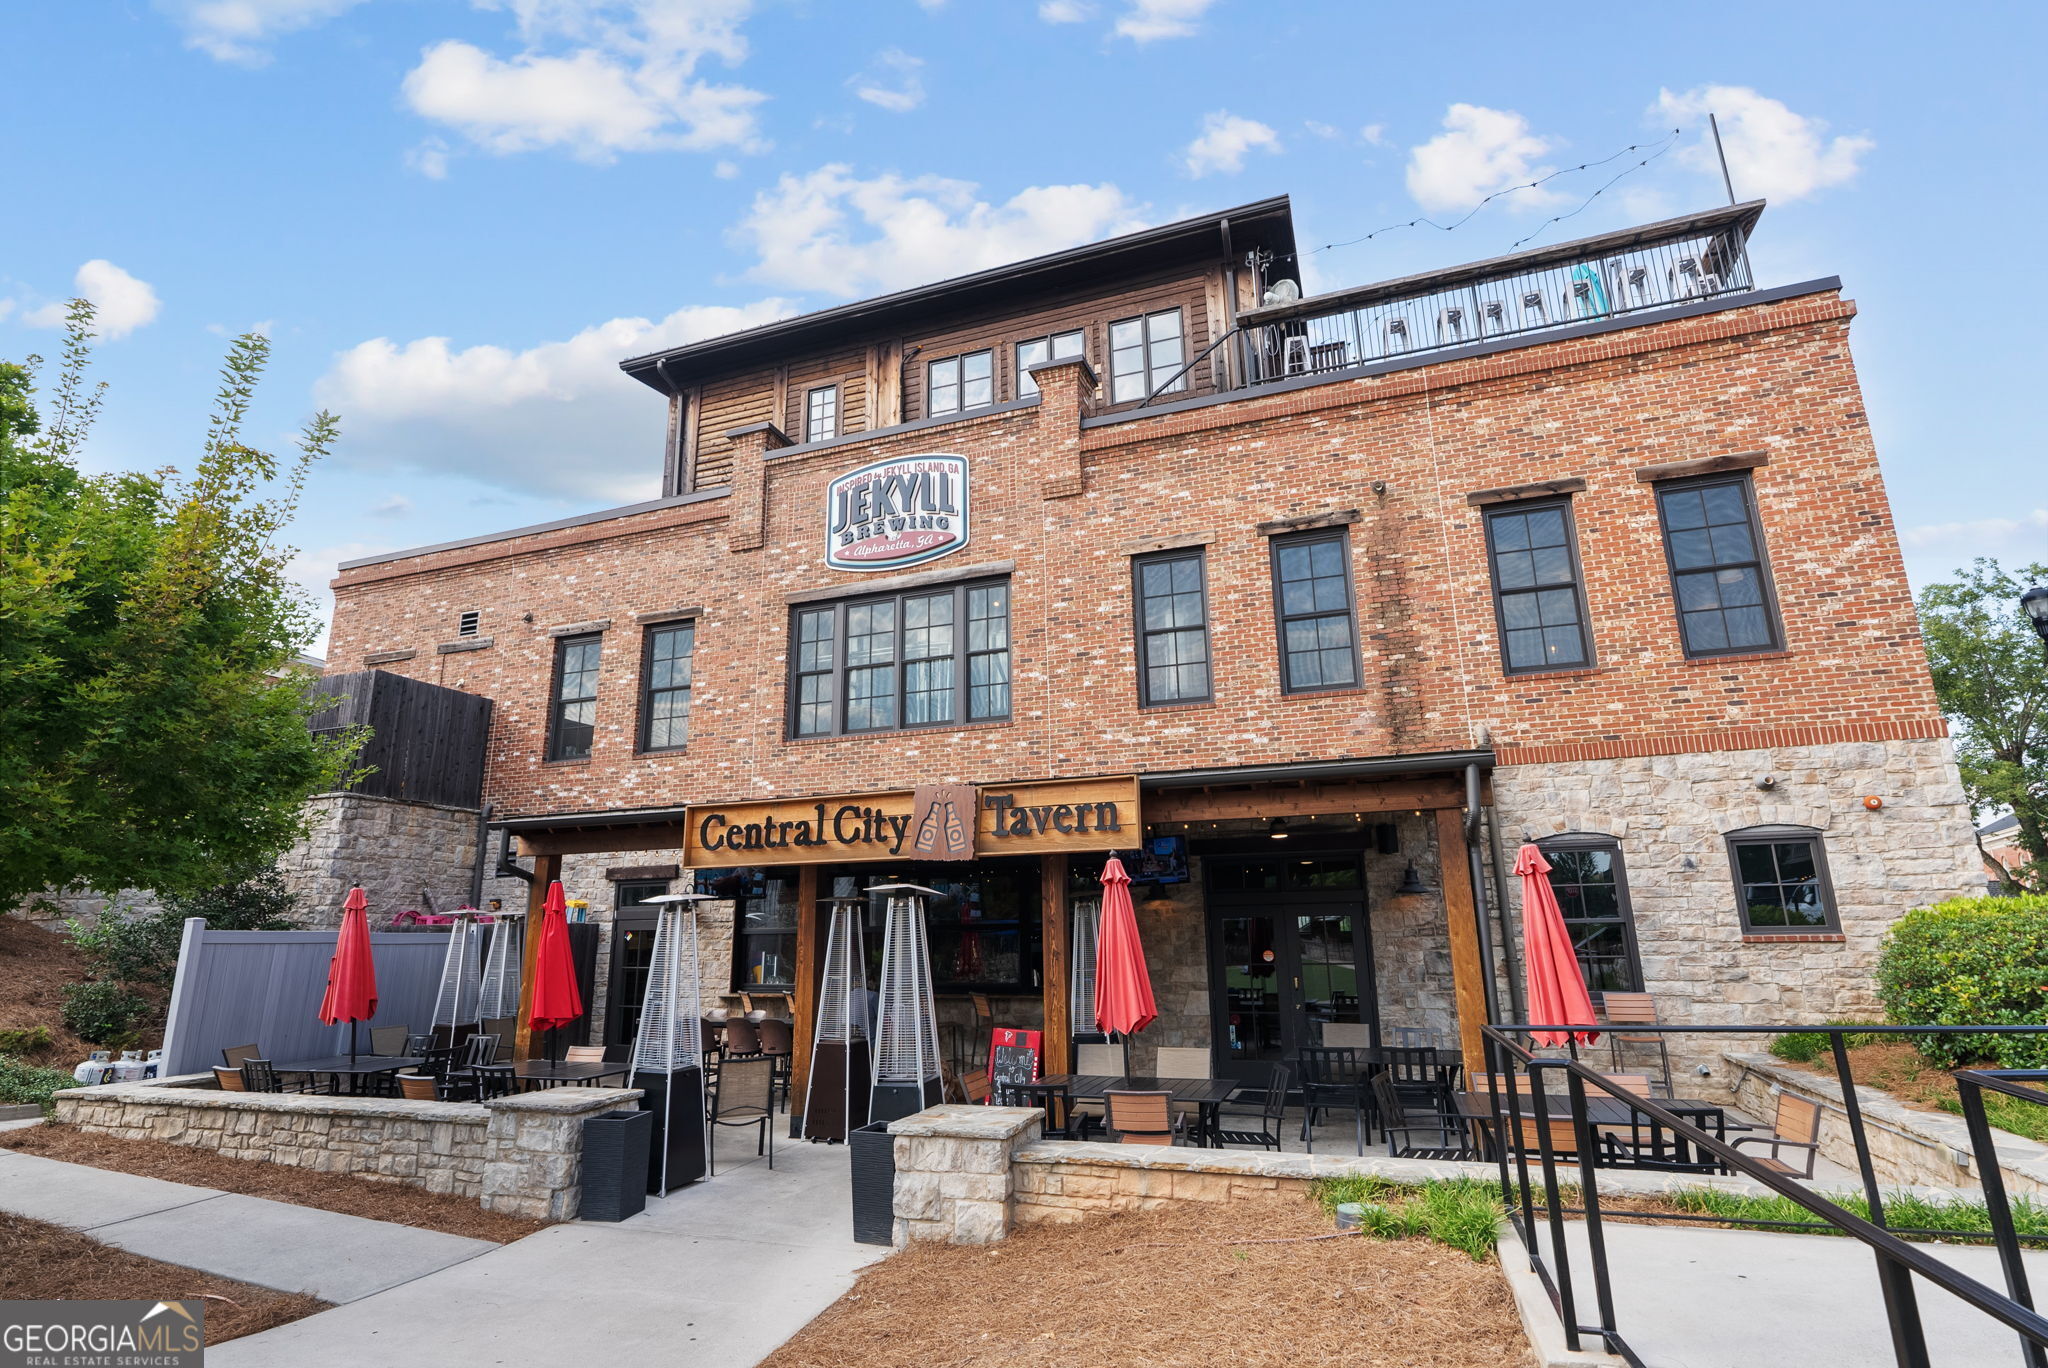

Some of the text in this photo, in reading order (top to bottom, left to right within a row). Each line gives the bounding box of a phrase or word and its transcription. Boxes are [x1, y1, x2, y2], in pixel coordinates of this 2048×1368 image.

[836, 473, 873, 496] INSPIRED
[874, 472, 882, 480] by
[883, 464, 912, 478] JEKYLL
[948, 463, 959, 475] GA
[833, 473, 958, 535] JEKYLL
[840, 515, 950, 547] BREWING
[853, 533, 934, 557] Alpharetta, GA
[700, 793, 1122, 855] Central City Tavern
